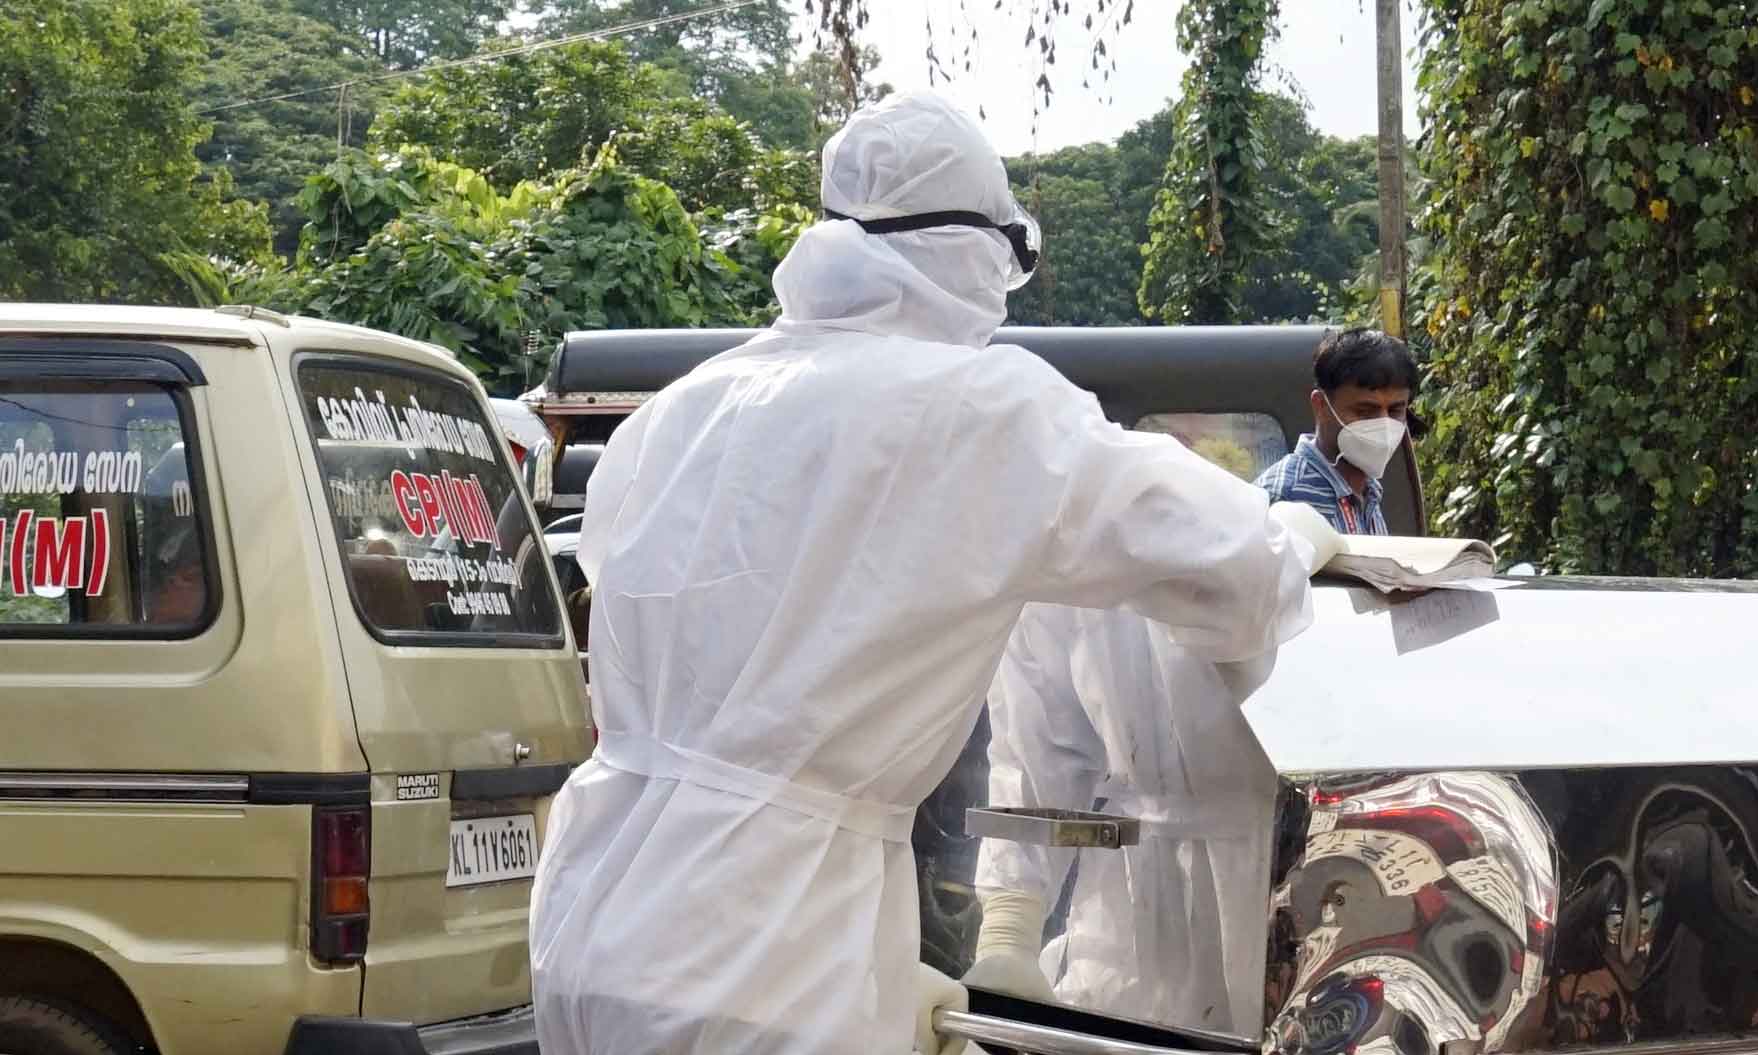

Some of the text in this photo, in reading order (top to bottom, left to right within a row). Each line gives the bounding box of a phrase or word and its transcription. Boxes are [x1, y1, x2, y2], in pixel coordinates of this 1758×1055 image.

[0, 438, 142, 494] തിരോധ സേന
[390, 469, 502, 551] CPI(M)
[0, 508, 110, 597] (M)
[397, 774, 439, 788] MARUTI
[397, 786, 439, 800] SUZUKI
